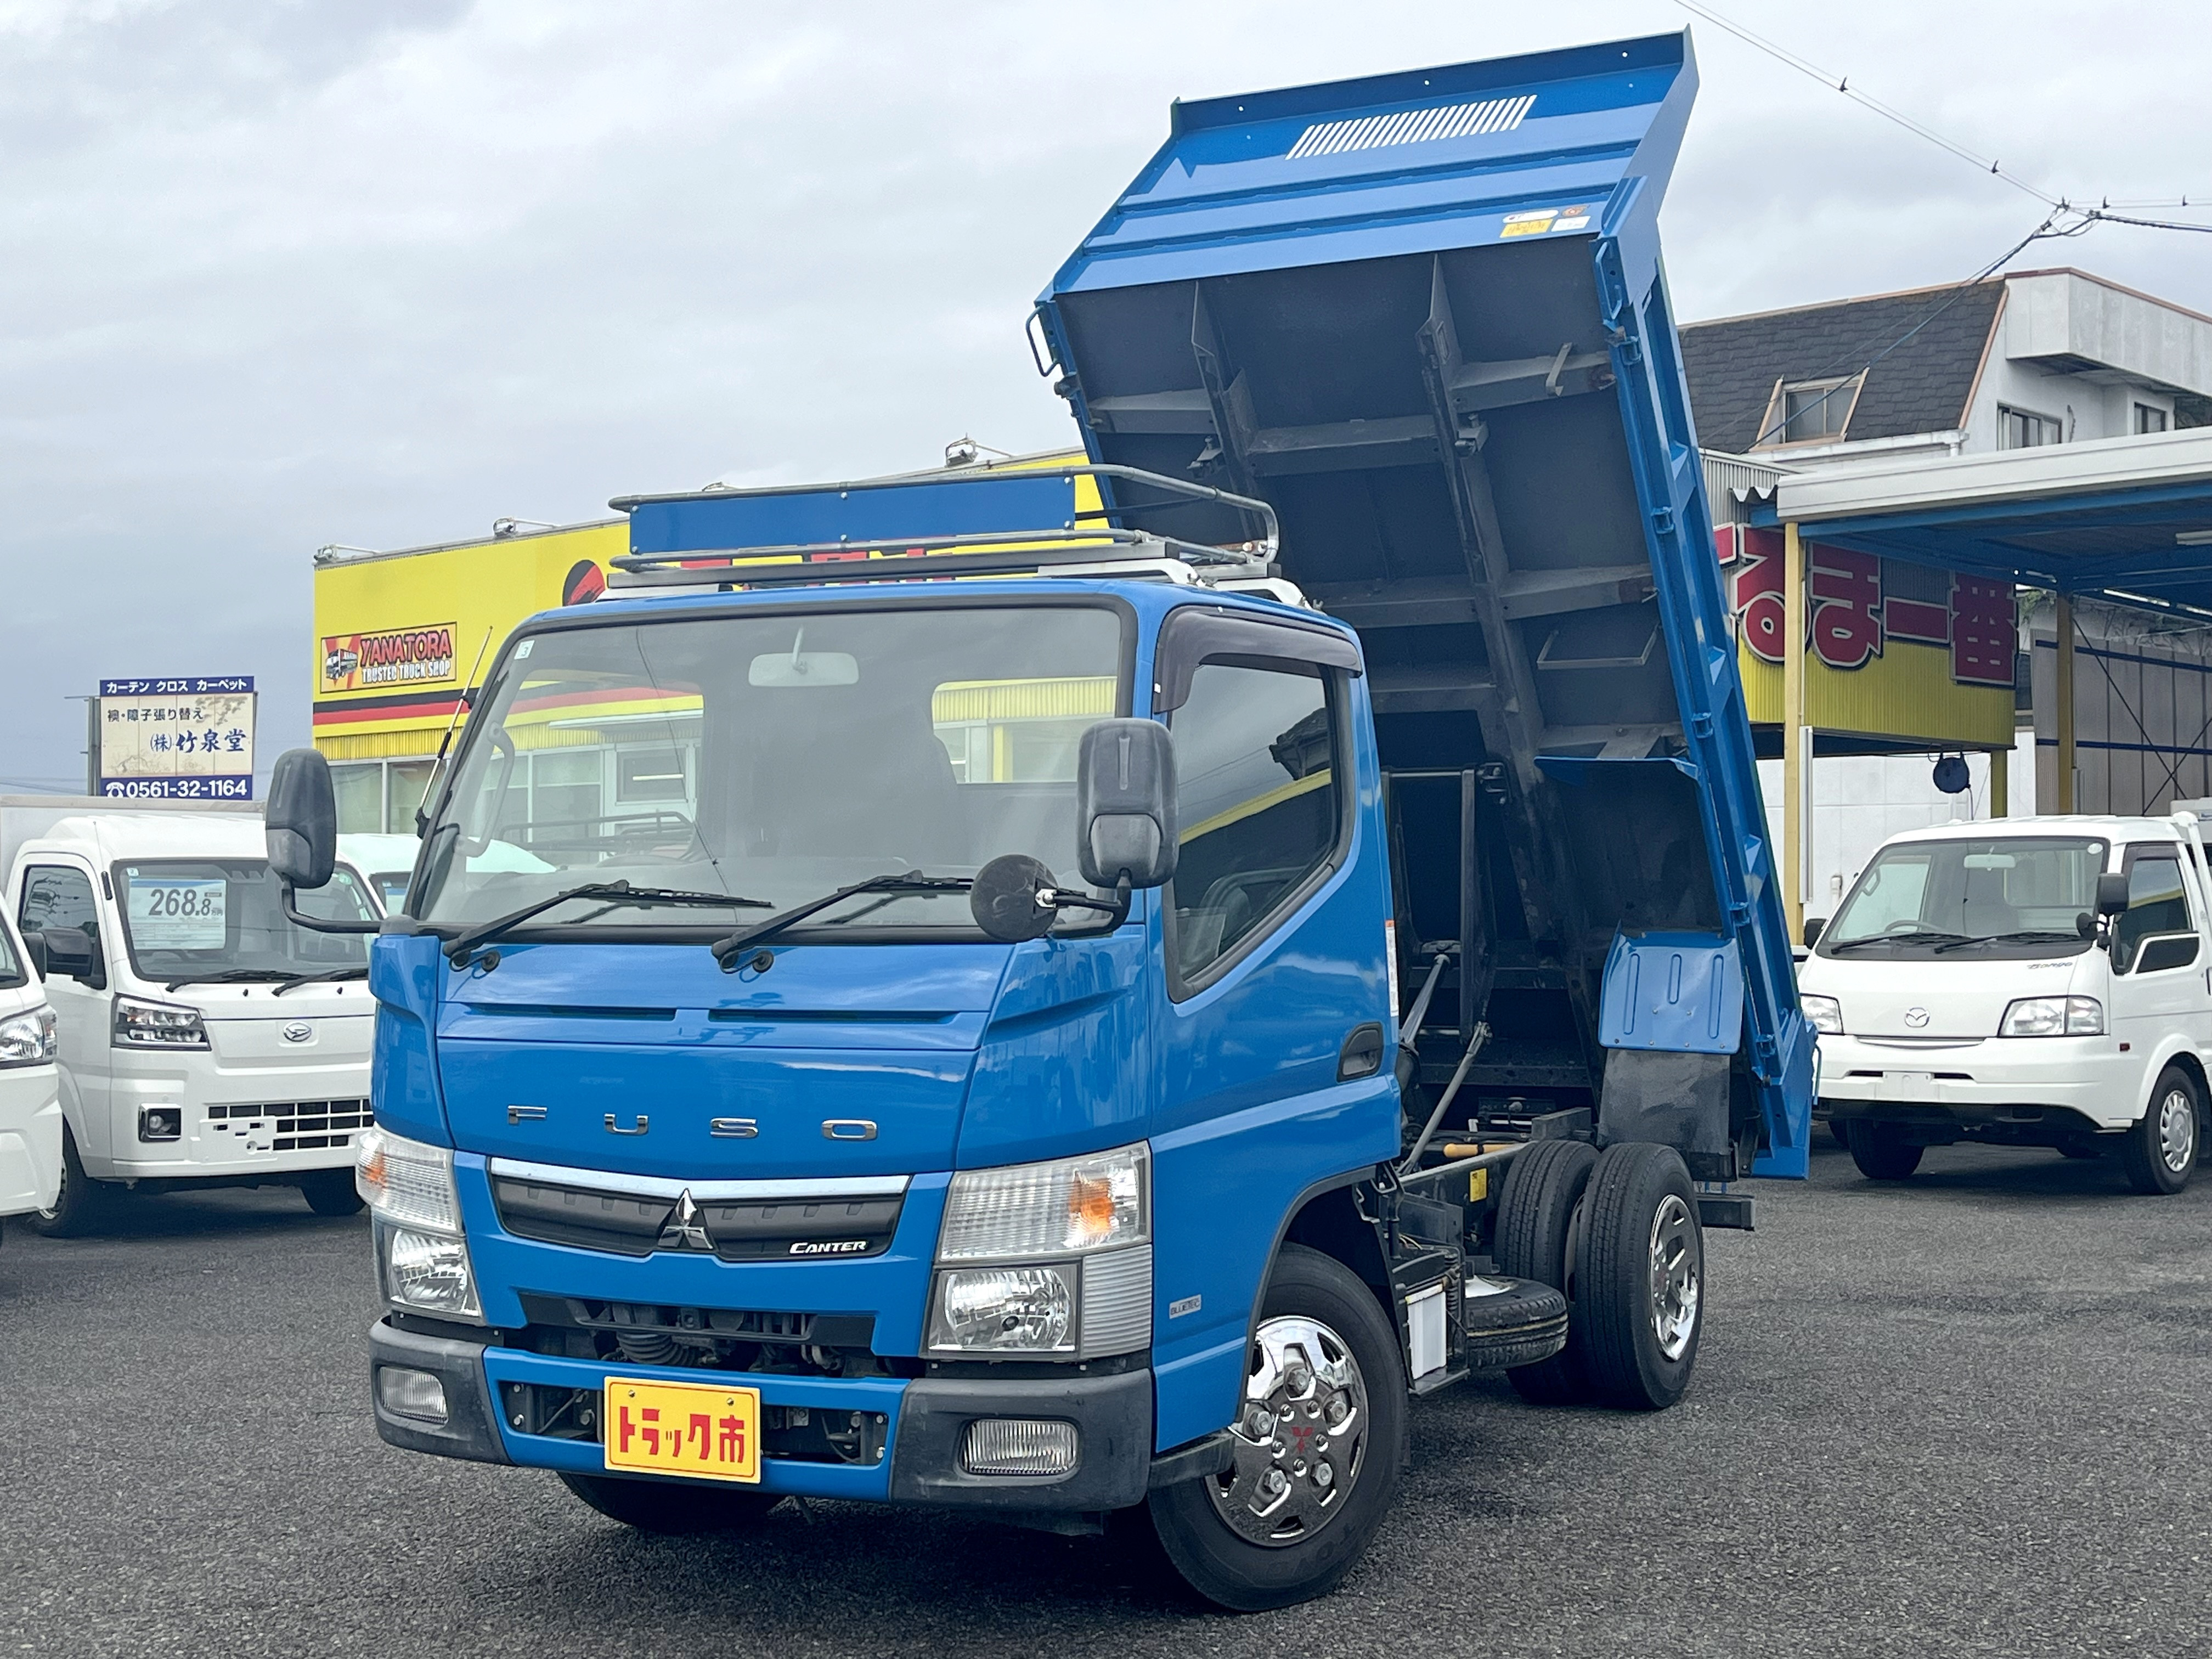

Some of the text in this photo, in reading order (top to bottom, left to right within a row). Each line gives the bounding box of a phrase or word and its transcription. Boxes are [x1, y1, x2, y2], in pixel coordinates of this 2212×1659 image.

[1713, 522, 2017, 686] るま一番
[360, 629, 453, 667] YANATORA
[107, 679, 247, 693] カーテン クロス カーペット
[362, 660, 450, 684] TRUSTED TRUCK SHOP
[126, 780, 247, 798] 0561-32-1164
[507, 1105, 878, 1141] FUSO
[620, 1406, 745, 1463] トラック市
